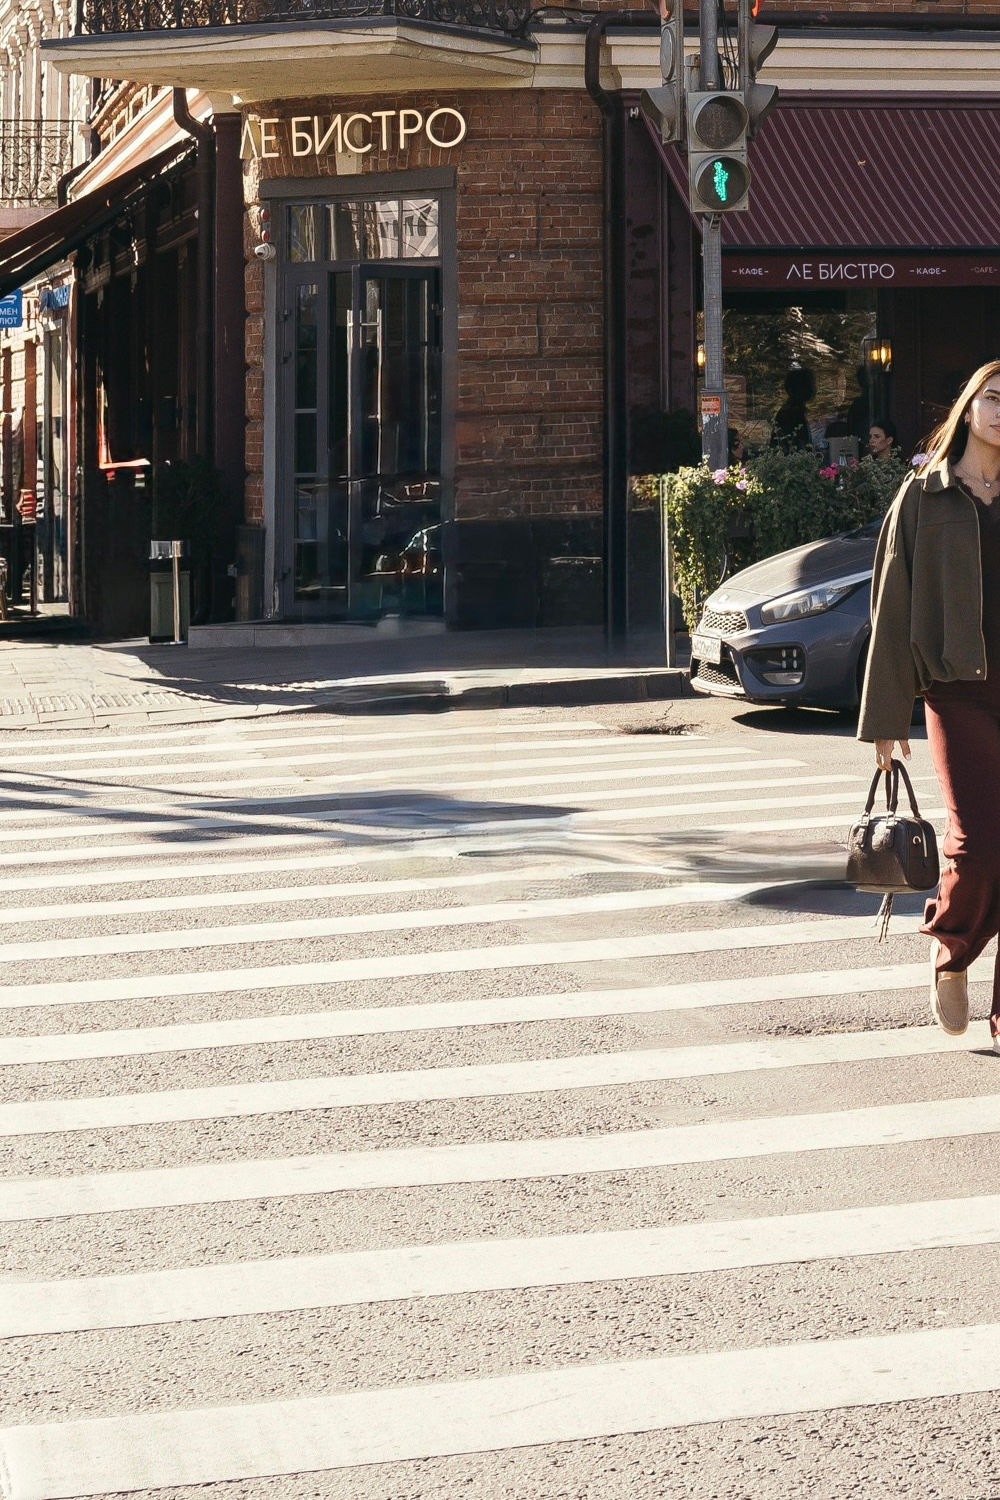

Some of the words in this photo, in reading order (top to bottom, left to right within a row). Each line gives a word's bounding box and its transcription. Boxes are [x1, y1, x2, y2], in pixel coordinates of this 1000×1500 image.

[239, 118, 280, 159] ЛЕ
[291, 107, 467, 157] БИСТРО
[786, 263, 813, 280] ЛЕ
[818, 263, 895, 280] БИСТРО
